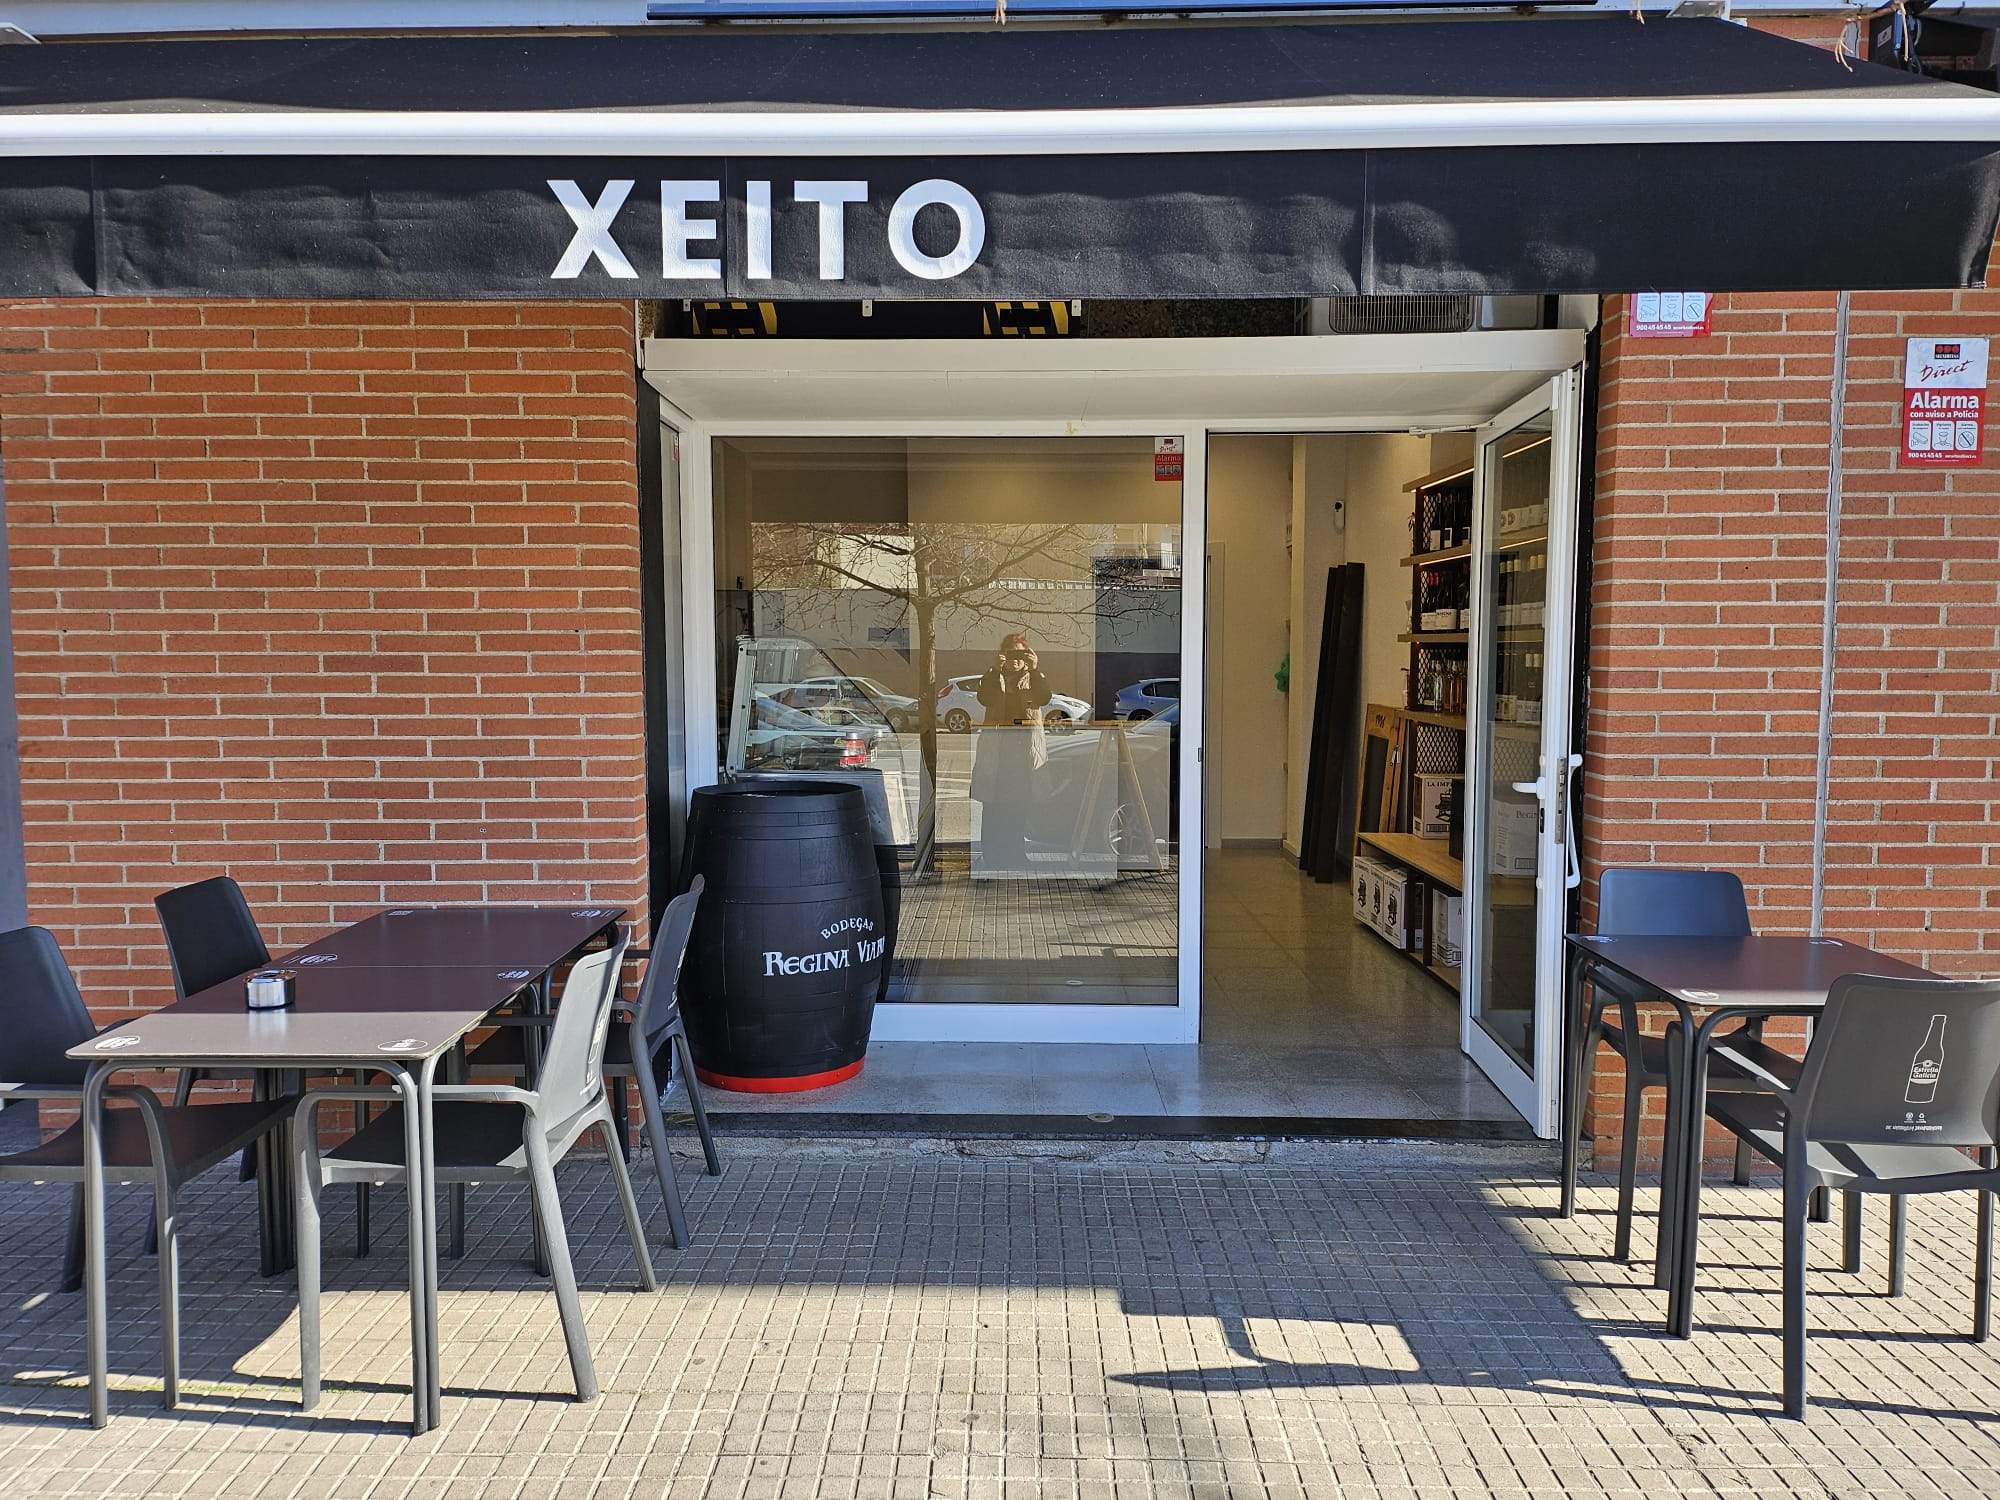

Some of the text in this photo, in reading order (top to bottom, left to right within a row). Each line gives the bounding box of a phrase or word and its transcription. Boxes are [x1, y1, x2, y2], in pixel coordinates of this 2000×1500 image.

[546, 178, 986, 280] XEITO
[1920, 360, 1975, 382] Direct
[1910, 391, 1979, 409] Alarma
[1925, 410, 1945, 418] aviso
[821, 917, 874, 940] BODEGAS
